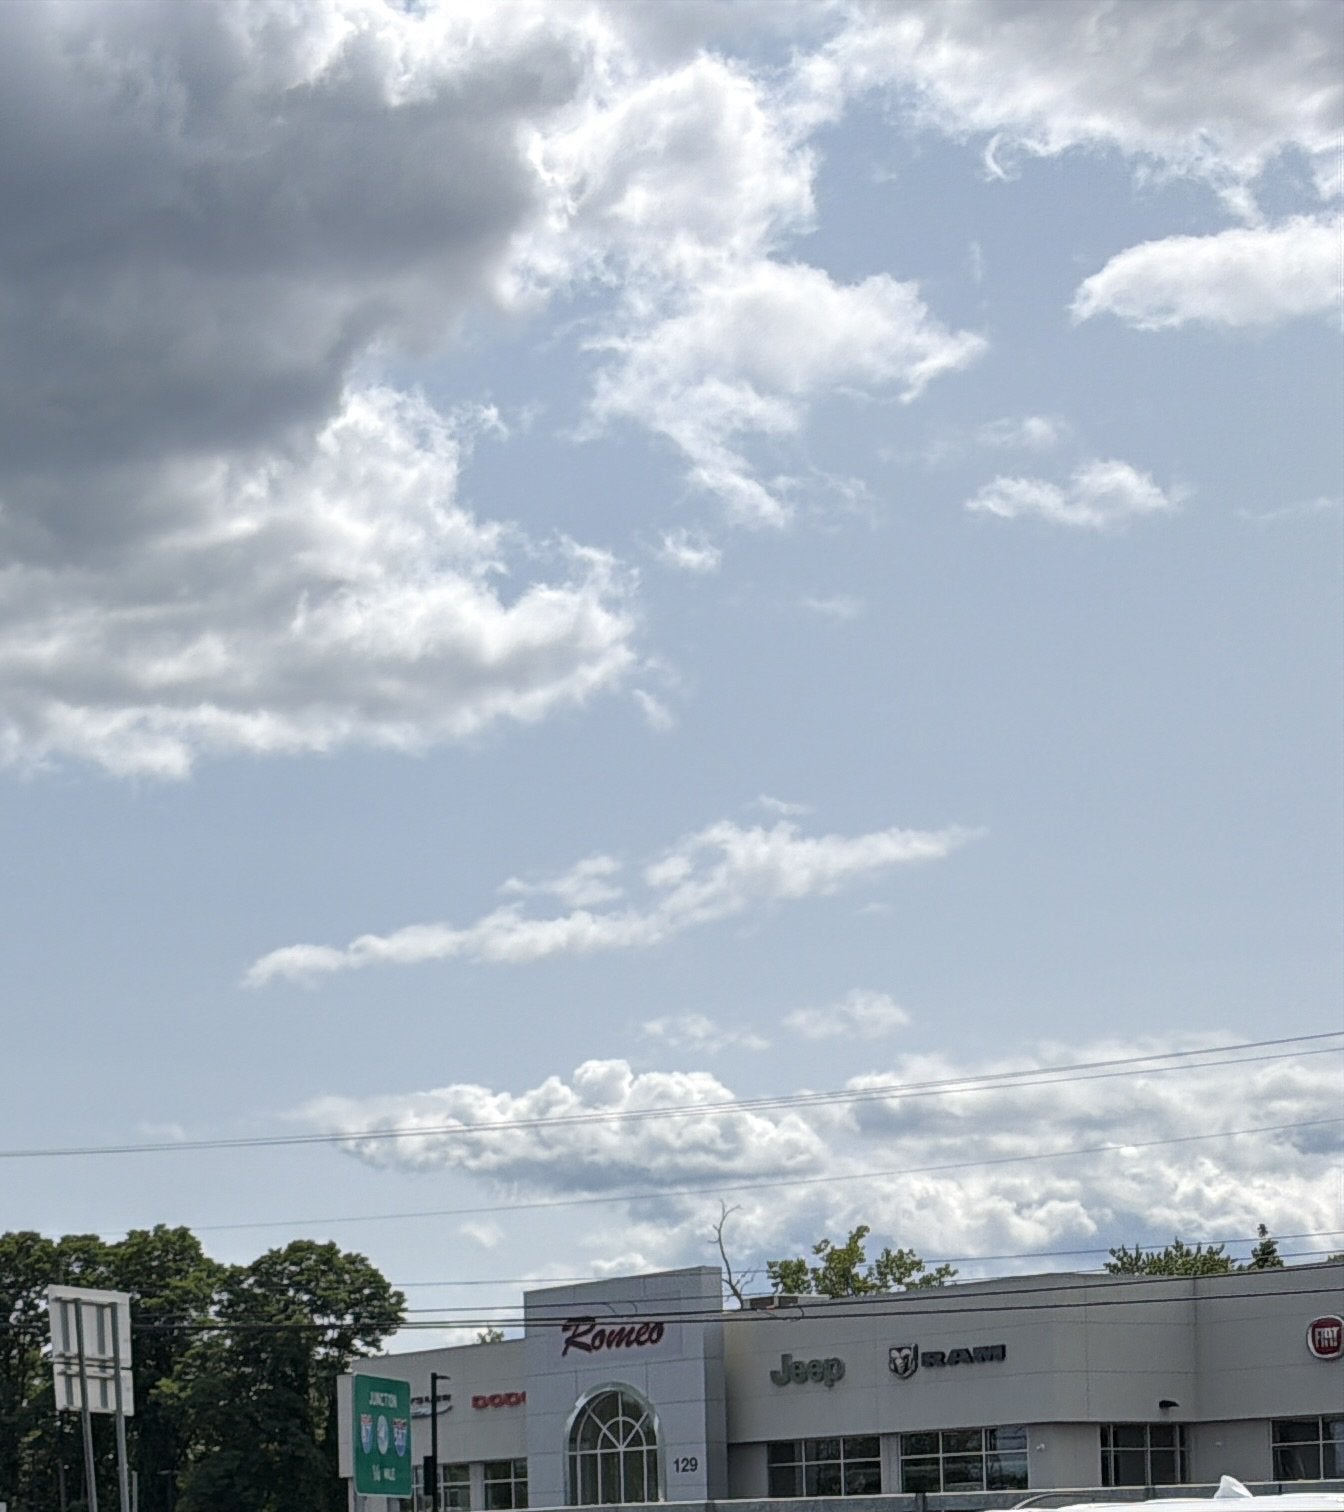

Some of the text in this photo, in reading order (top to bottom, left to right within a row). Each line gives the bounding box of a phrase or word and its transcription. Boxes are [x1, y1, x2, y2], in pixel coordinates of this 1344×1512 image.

[562, 1316, 665, 1357] Romeo
[1314, 1326, 1340, 1348] FIAT
[921, 1344, 1006, 1368] RAM
[769, 1354, 846, 1390] Jeep
[471, 1391, 527, 1409] DOD
[673, 1457, 699, 1473] 129
